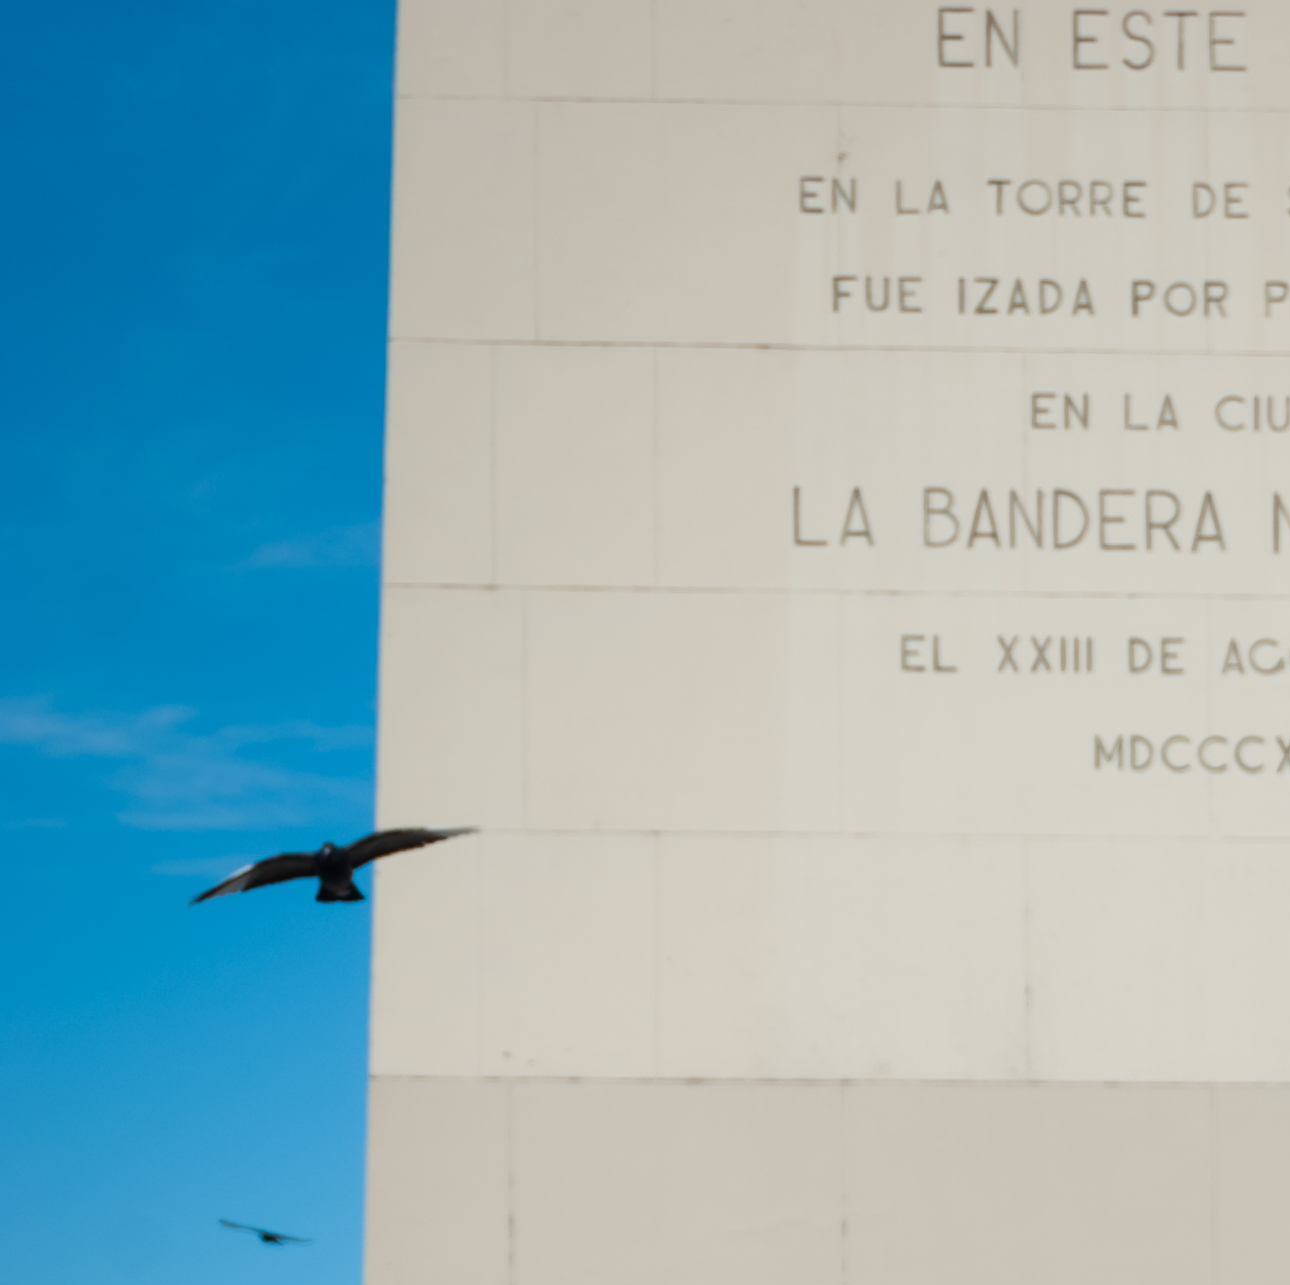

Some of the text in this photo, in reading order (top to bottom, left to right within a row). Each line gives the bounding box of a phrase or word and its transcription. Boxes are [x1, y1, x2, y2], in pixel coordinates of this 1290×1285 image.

[937, 6, 1019, 68] EN
[1072, 8, 1246, 72] ESTE
[799, 176, 857, 214] EN
[896, 180, 949, 215] LA
[987, 178, 1147, 218] TORRE
[1192, 182, 1248, 219] DE
[832, 274, 923, 313] FUE
[958, 277, 1095, 316] IZADA
[1131, 279, 1229, 317] POR
[1031, 392, 1090, 429] EN
[1124, 394, 1179, 431] LA
[793, 486, 874, 547] LA
[923, 486, 1226, 553] BANDERA
[901, 635, 957, 673] EL
[998, 636, 1093, 673] XXIII
[1128, 637, 1184, 675] DE
